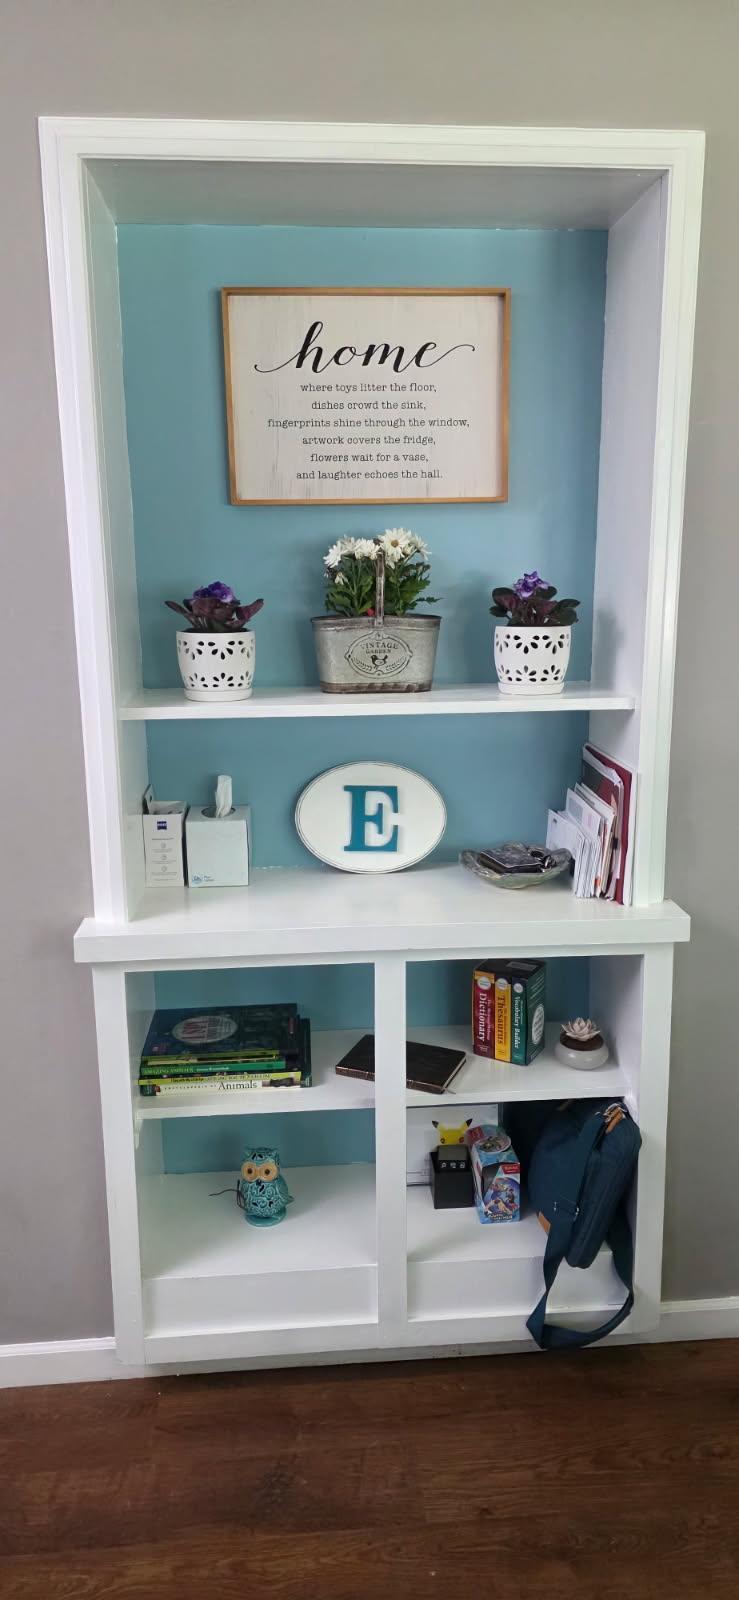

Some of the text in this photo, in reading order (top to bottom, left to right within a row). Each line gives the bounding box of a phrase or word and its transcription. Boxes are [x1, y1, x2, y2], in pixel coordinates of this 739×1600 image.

[253, 321, 476, 374] home
[300, 382, 437, 394] where toys litter the floor,
[311, 400, 426, 411] dishes crowd the sink,
[267, 417, 470, 429] fingerprints shine through the window,
[302, 435, 436, 446] artwork covers the fridge,
[310, 452, 429, 463] flowers wait for a vase,
[296, 469, 443, 481] and laughter echoes the hall.
[360, 642, 399, 650] VINTAGE
[343, 785, 399, 852] E
[478, 993, 488, 1042] Dictionary
[497, 996, 506, 1045] Thesaurus
[218, 1079, 258, 1090] Animals
